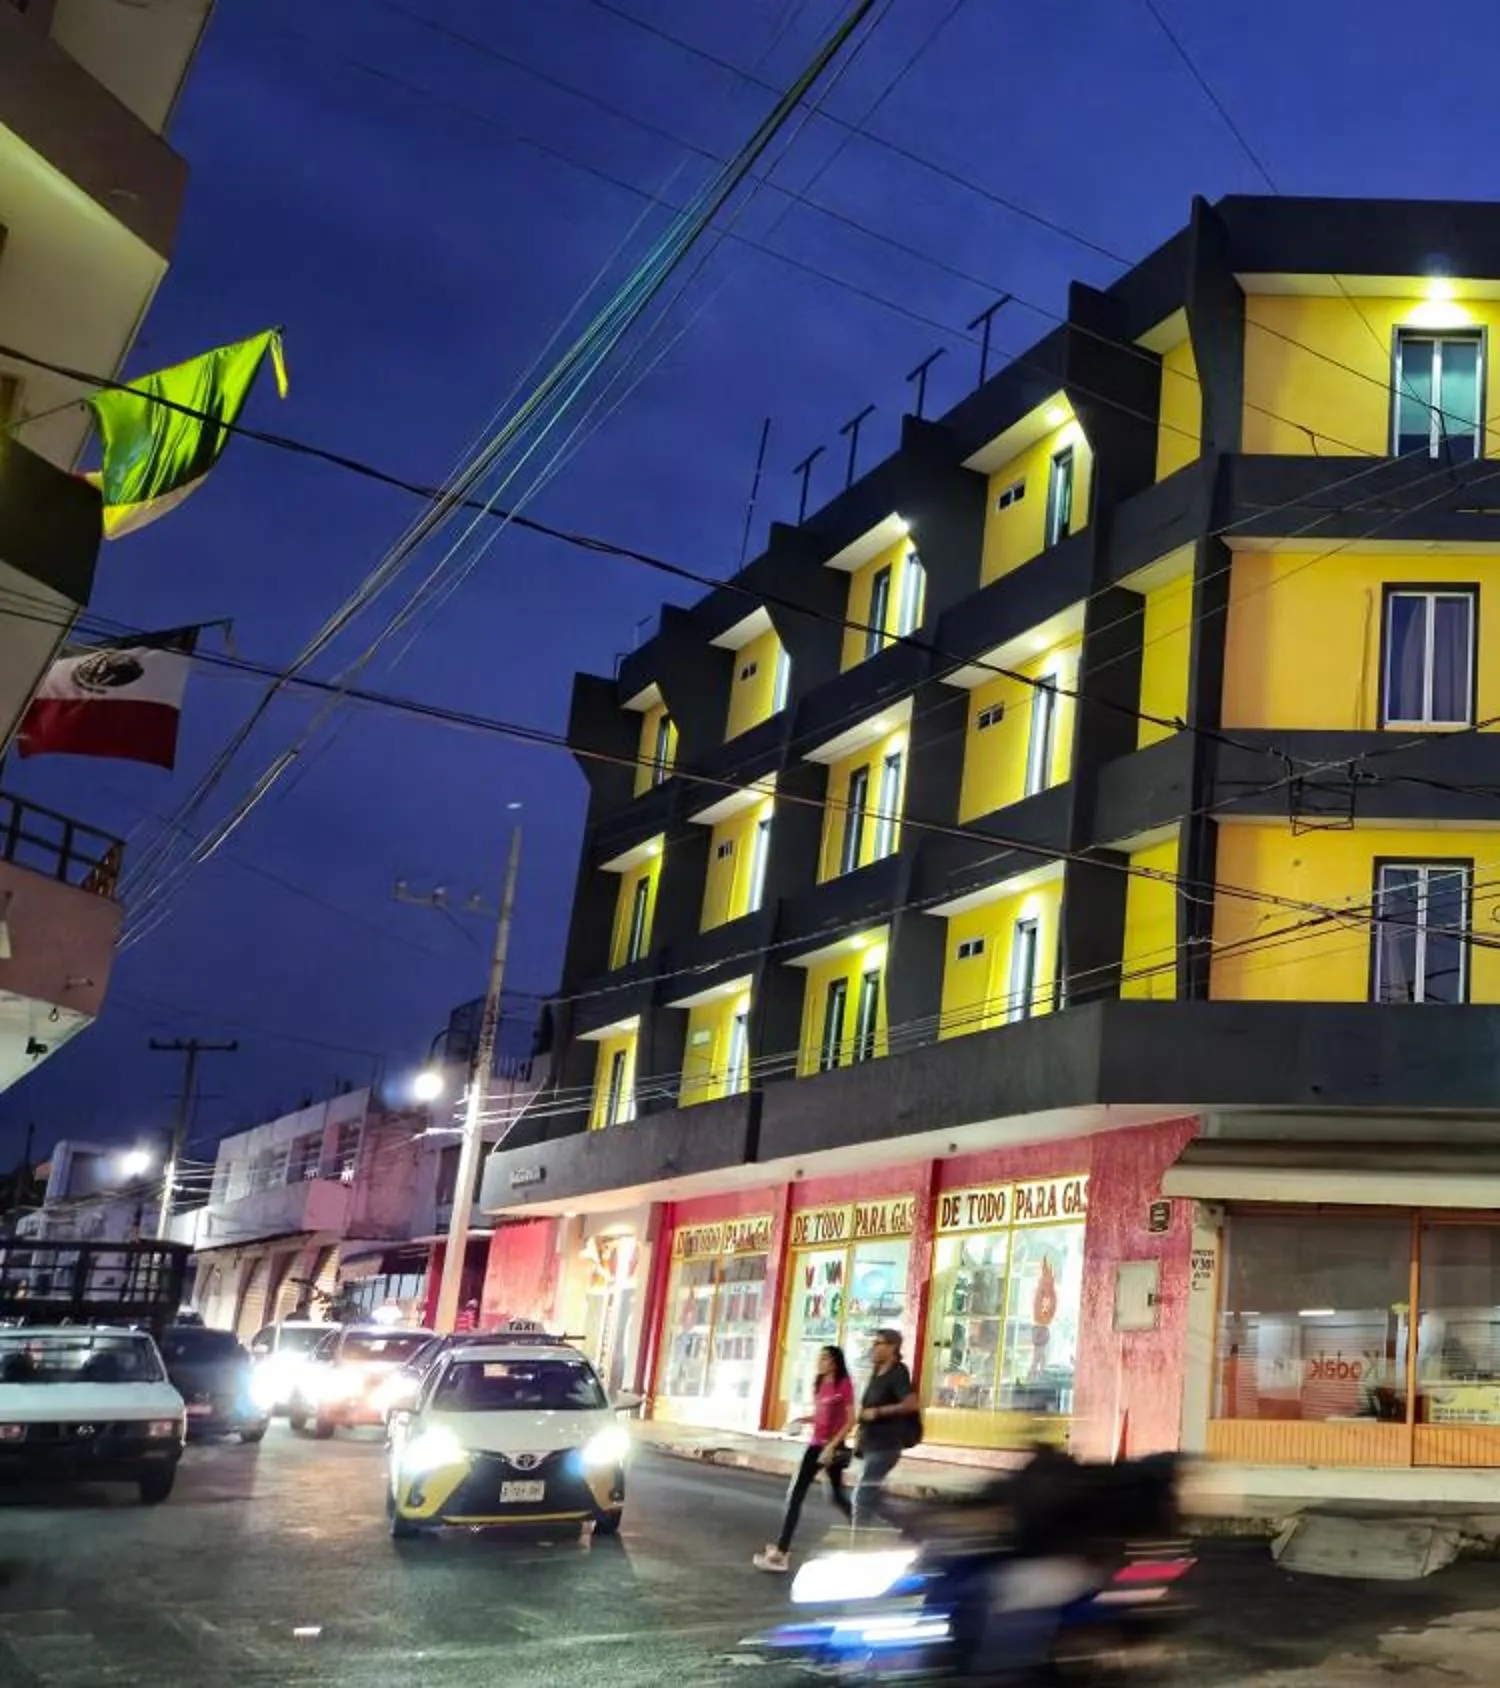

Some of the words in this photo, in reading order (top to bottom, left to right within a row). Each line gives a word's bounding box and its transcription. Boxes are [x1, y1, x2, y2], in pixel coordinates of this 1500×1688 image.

[794, 1215, 808, 1243] DE
[814, 1211, 845, 1241] TODO
[855, 1205, 887, 1236] PARA
[941, 1194, 962, 1227] DE
[967, 1191, 1006, 1225] TODO
[1014, 1183, 1057, 1220] PARA
[509, 1321, 536, 1332] TAXI
